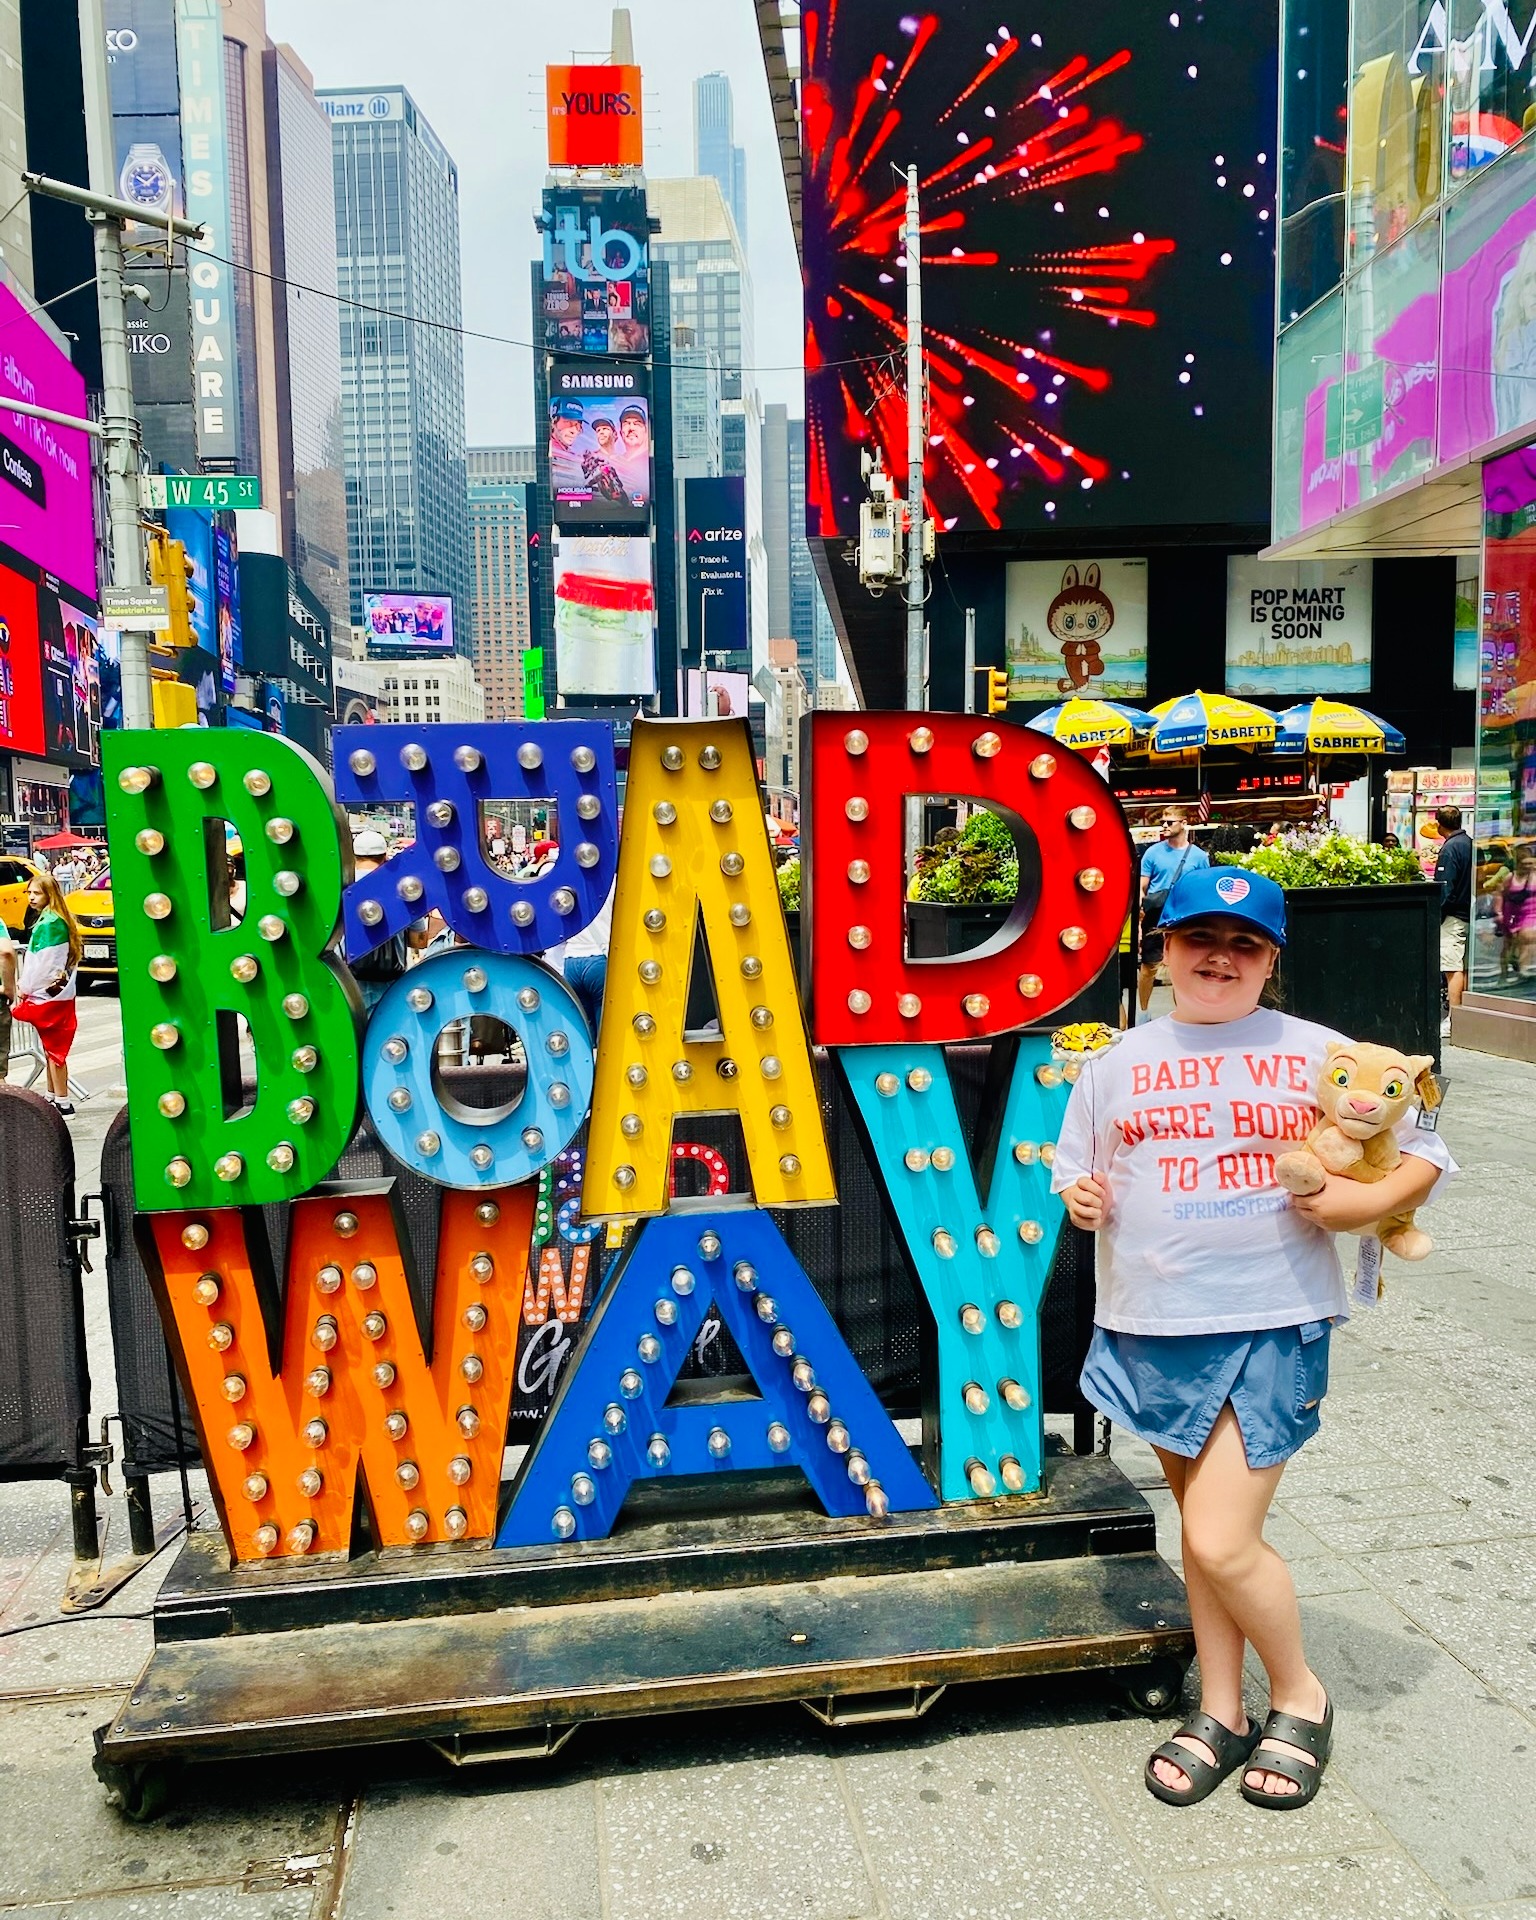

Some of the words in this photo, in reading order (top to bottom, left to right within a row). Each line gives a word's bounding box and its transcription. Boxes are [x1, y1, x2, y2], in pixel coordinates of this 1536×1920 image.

[183, 22, 214, 198] TIMES
[320, 101, 365, 117] lianz
[561, 92, 637, 116] YOURS.
[126, 319, 149, 329] assic
[192, 225, 225, 435] SQUARE
[127, 333, 172, 354] IKO
[561, 374, 634, 389] SAMSUNG
[3, 448, 33, 489] Confess
[171, 480, 192, 505] W
[203, 481, 229, 506] 45
[238, 481, 253, 496] St
[704, 526, 743, 542] arize
[699, 555, 721, 564] Trace
[700, 571, 734, 580] Evaluate
[703, 587, 715, 596] Fix
[1250, 588, 1288, 606] POP
[1292, 587, 1346, 605] MART
[105, 597, 130, 606] Times
[129, 597, 158, 607] Square
[106, 606, 145, 615] Pedestrian
[145, 606, 166, 614] Plaza
[1250, 606, 1268, 623] IS
[1271, 605, 1345, 623] COMING
[1271, 622, 1322, 640] SOON
[1212, 725, 1272, 740] SABRETT
[1313, 736, 1380, 749] SABRETT
[1131, 1055, 1225, 1096] BABY
[1243, 1054, 1309, 1093] WE
[1113, 1101, 1215, 1147] WERE
[1229, 1100, 1318, 1142] BORN
[1158, 1156, 1199, 1193] TO
